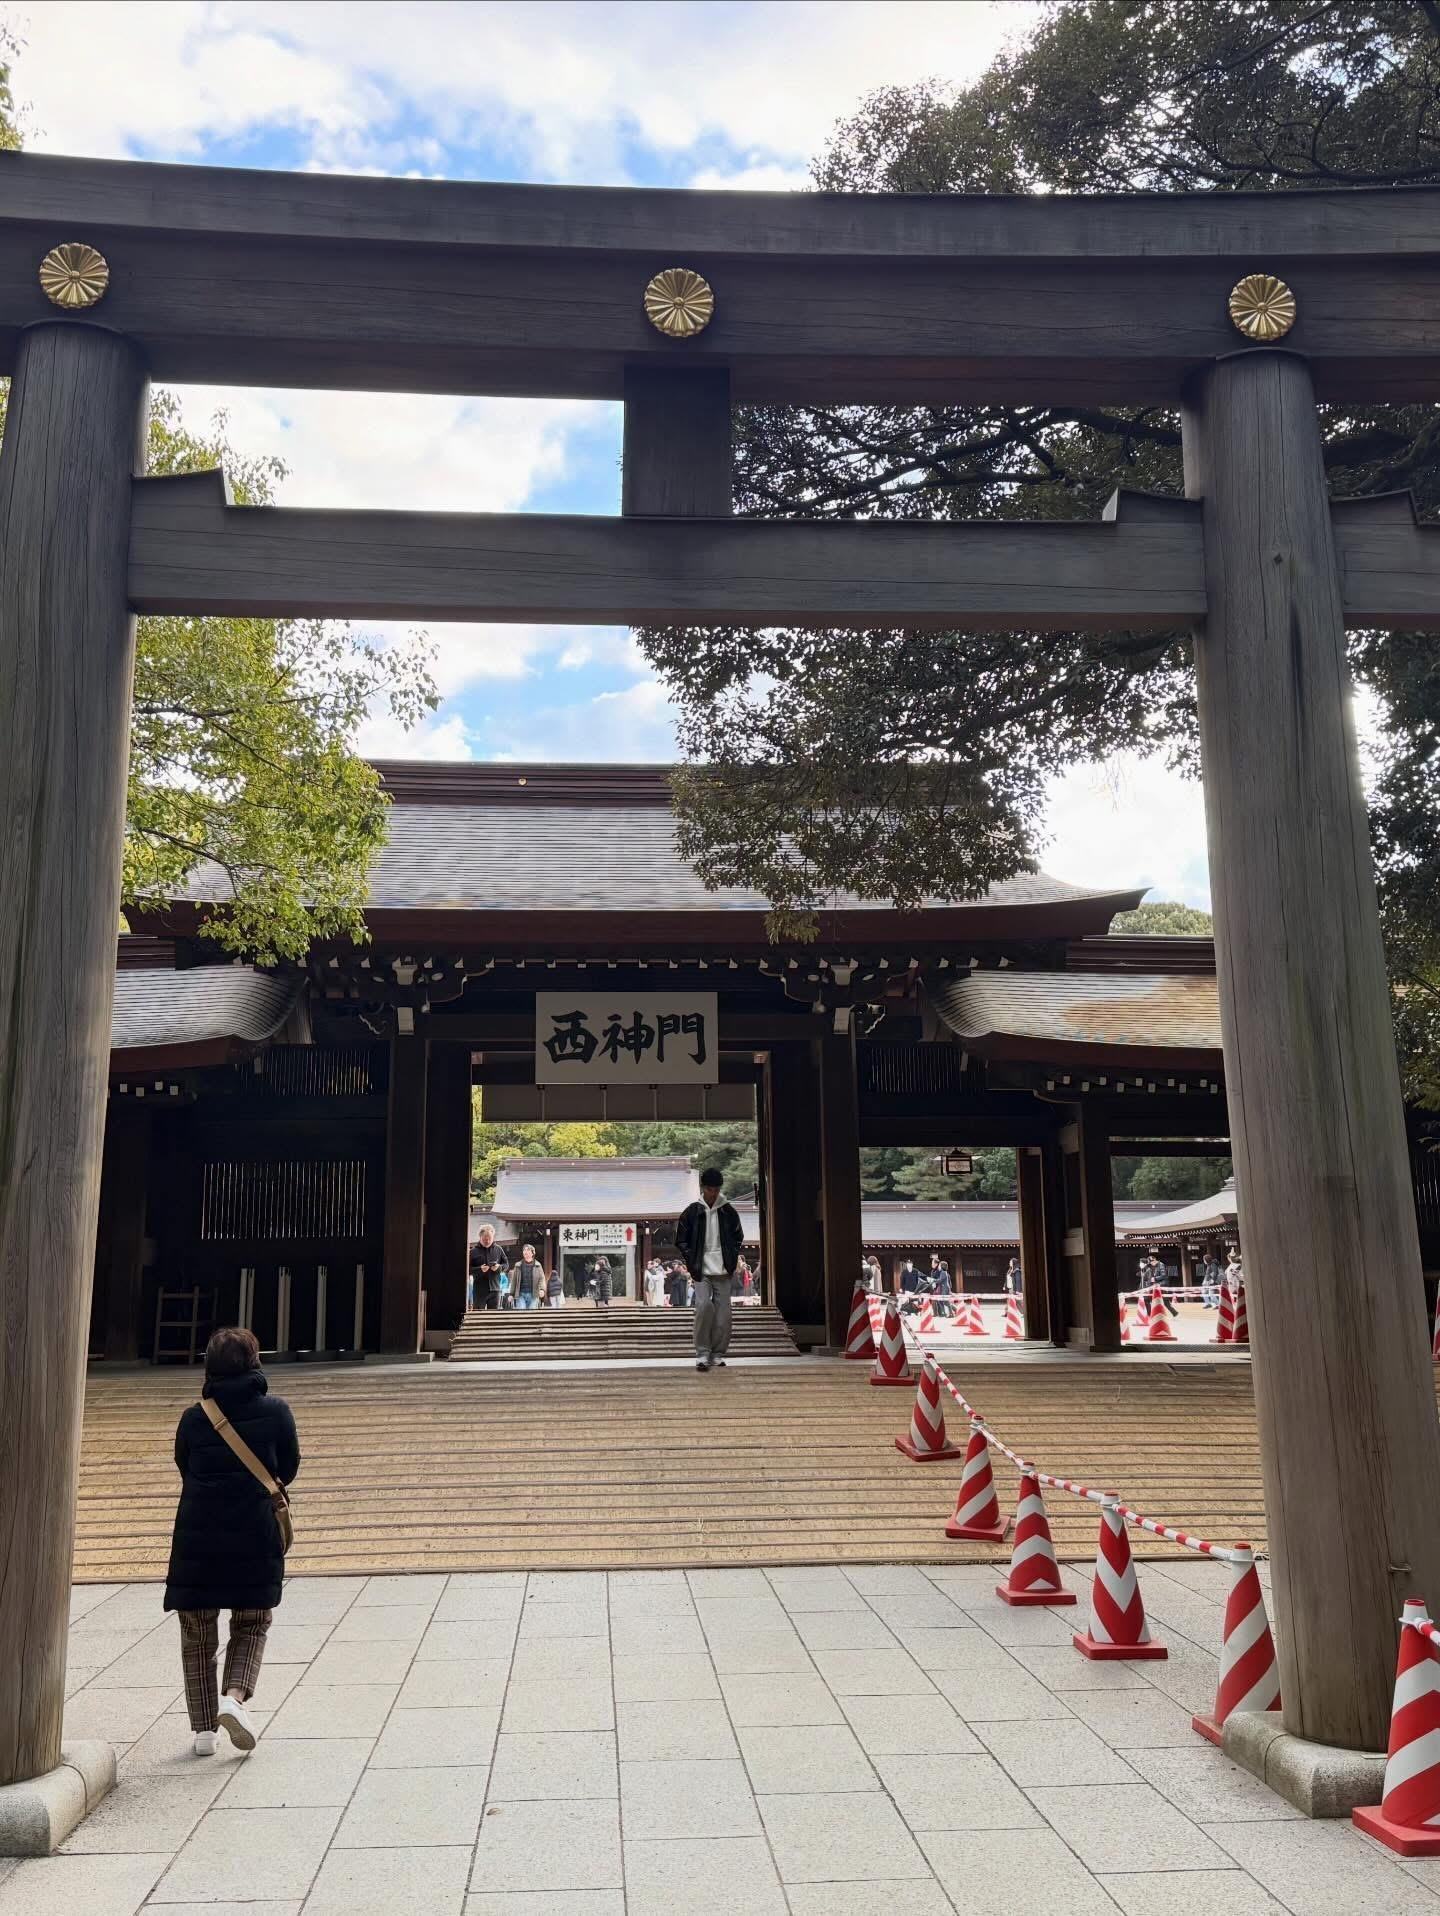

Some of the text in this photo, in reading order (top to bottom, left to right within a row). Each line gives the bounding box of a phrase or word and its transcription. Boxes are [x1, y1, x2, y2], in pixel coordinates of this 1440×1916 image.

[542, 1009, 707, 1066] 西神門
[563, 1228, 599, 1242] 東神門
